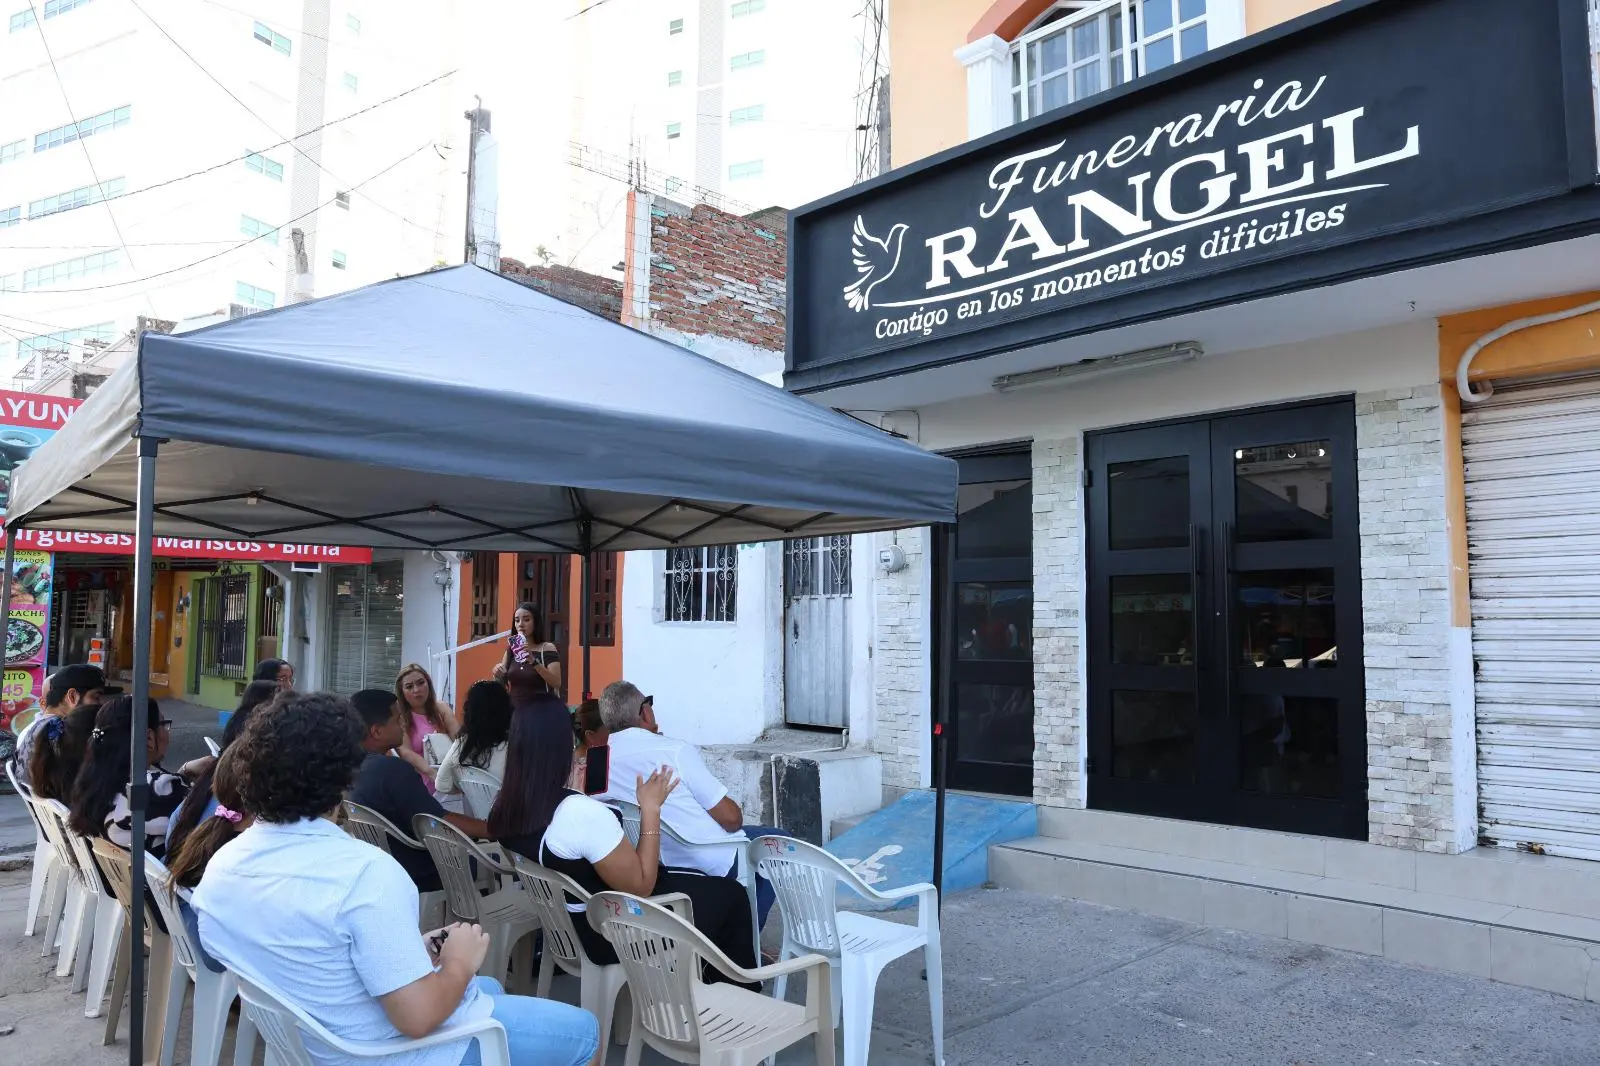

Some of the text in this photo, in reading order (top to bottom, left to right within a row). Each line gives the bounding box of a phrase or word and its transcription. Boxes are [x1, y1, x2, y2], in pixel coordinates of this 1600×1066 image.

[925, 107, 1420, 290] RANGEL
[980, 75, 1327, 219] Funeraria
[875, 203, 1347, 339] Contigo en los momentos dificiles
[156, 537, 262, 552] Mariscos
[282, 544, 340, 556] Birria
[3, 672, 26, 681] RITO
